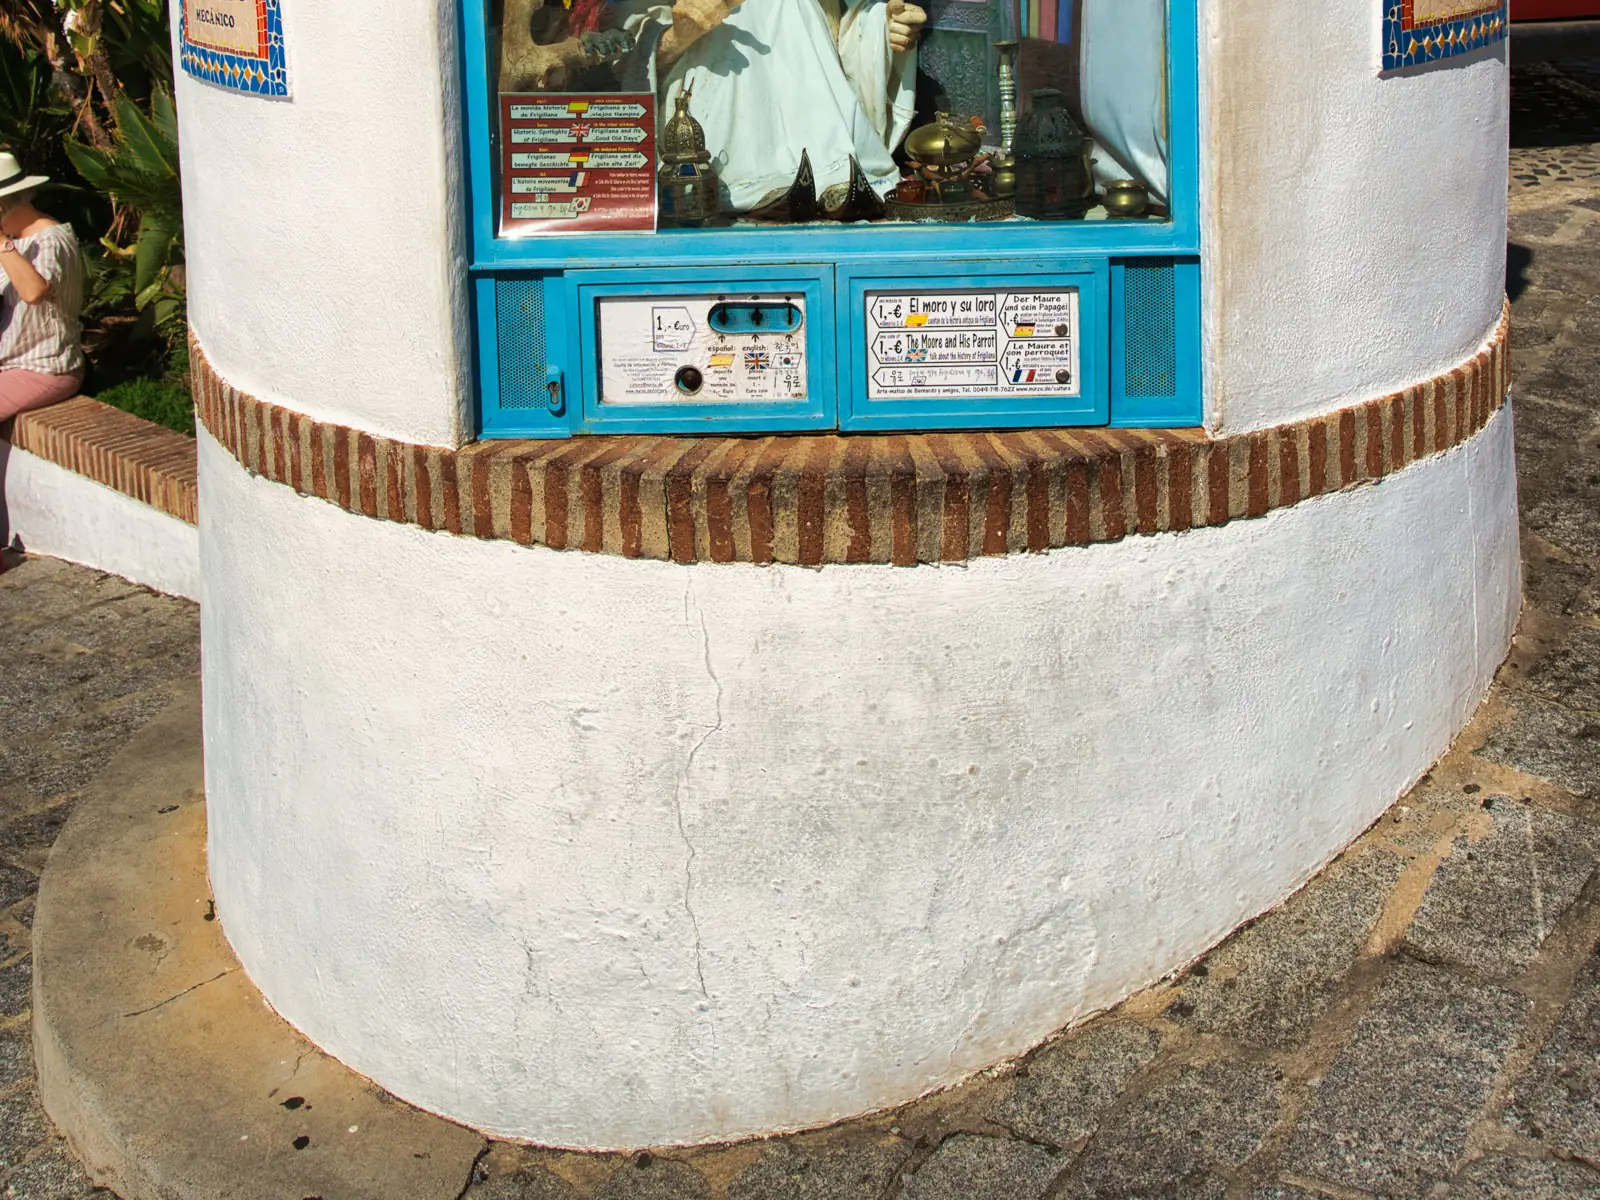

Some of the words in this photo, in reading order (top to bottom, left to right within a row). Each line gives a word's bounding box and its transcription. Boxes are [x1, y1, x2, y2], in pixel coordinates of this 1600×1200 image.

[196, 6, 235, 28] MECÁNICO
[1013, 295, 1030, 303] Der
[1033, 295, 1062, 303] Maure
[909, 297, 919, 313] El
[922, 300, 948, 313] moro
[951, 300, 957, 317] y
[960, 300, 972, 312] su
[975, 296, 995, 313] loro
[1004, 303, 1019, 312] und
[1020, 303, 1037, 312] sein
[1039, 302, 1068, 312] Papagei
[906, 333, 920, 349] The
[921, 333, 943, 349] Moore
[944, 333, 957, 349] and
[959, 333, 971, 348] His
[972, 333, 995, 348] Parrot
[707, 344, 736, 353] español:
[742, 344, 769, 352] english:
[1013, 342, 1025, 350] Le
[1027, 342, 1057, 350] Maure
[1059, 342, 1069, 350] et
[938, 352, 949, 361] about
[957, 351, 971, 361] history
[1024, 349, 1068, 357] perroquet
